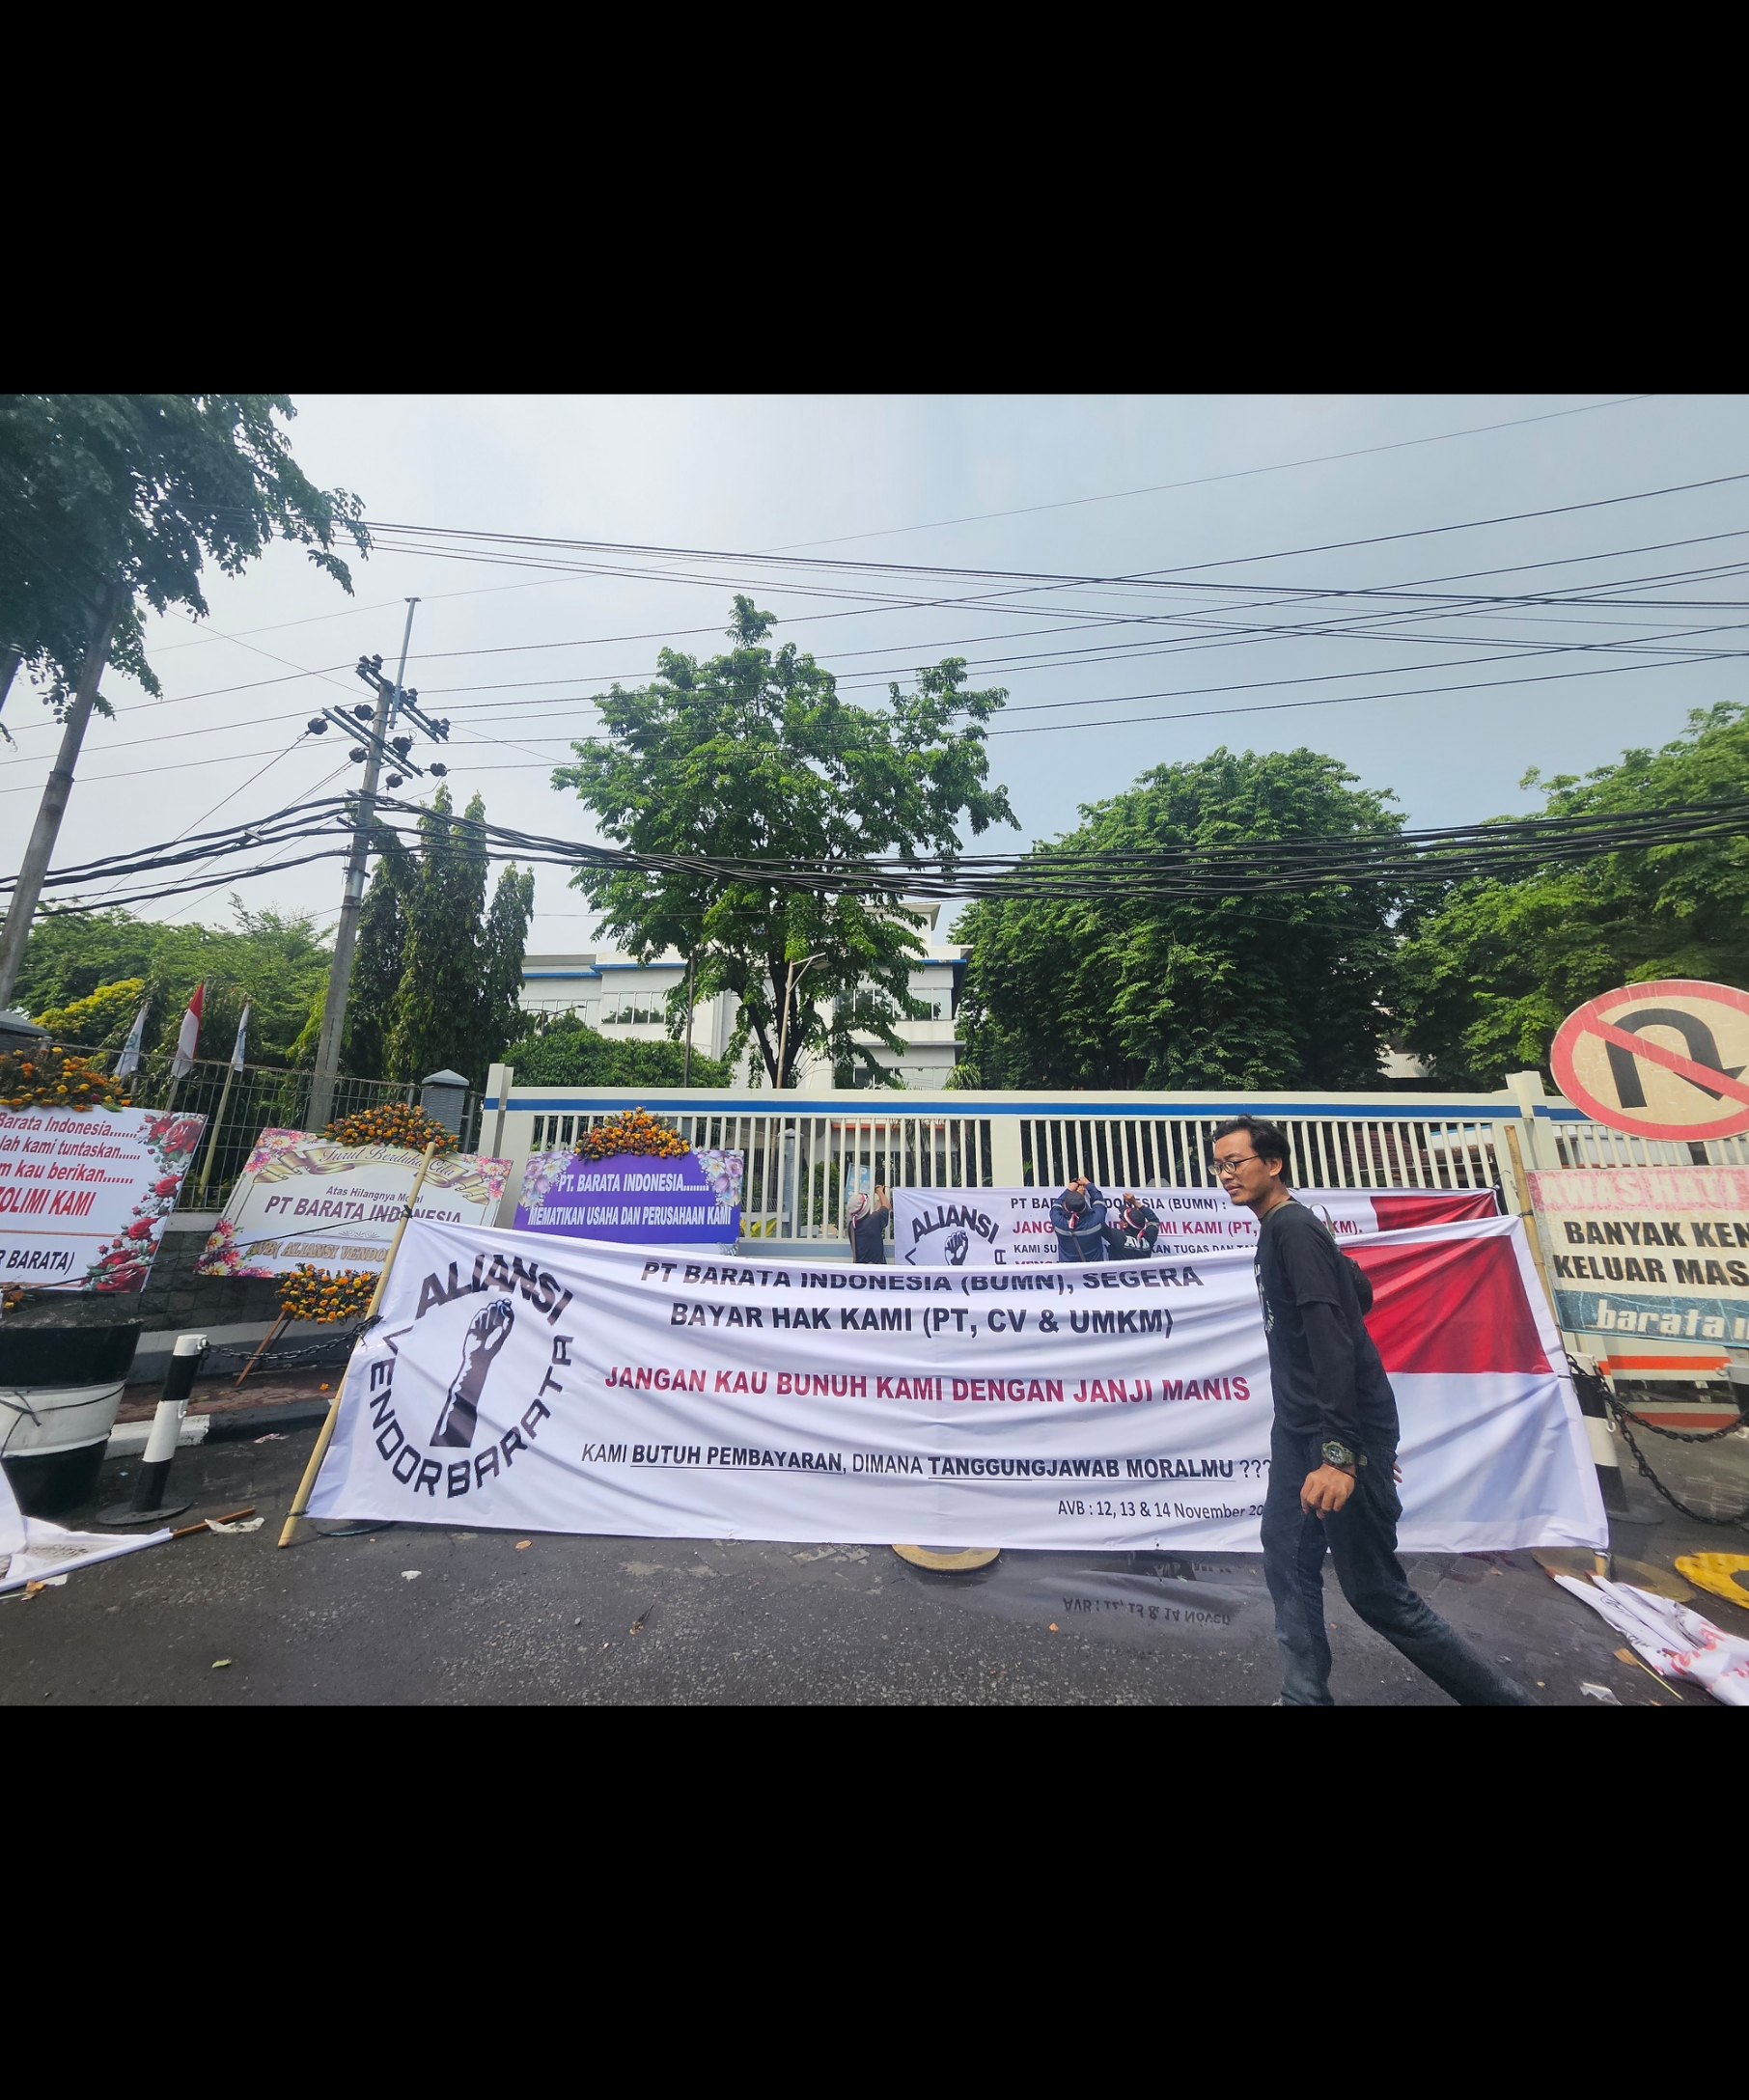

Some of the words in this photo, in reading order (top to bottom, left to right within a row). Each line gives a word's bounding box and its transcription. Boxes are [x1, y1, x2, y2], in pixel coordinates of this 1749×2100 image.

[0, 1135, 20, 1152] lah
[22, 1136, 56, 1155] kami
[14, 1159, 45, 1179] kau
[326, 1185, 348, 1197] Atas
[349, 1187, 396, 1202] Hilangnya
[397, 1193, 424, 1203] Moal
[557, 1174, 574, 1192] PT.
[576, 1174, 621, 1192] BARATA
[48, 1191, 97, 1216] KAMI
[264, 1196, 293, 1214] PT
[293, 1198, 365, 1221] BARATA
[369, 1203, 462, 1223] INDNESIA
[527, 1205, 585, 1226] MEMATIKAN
[586, 1205, 619, 1226] USAHA
[620, 1206, 640, 1226] DAN
[642, 1206, 705, 1226] PERUSAHAAN
[707, 1206, 732, 1226] KAMI
[1011, 1198, 1027, 1209] PT
[1168, 1198, 1218, 1212] (BUMN)
[911, 1204, 1000, 1245] ALIANSI
[1012, 1221, 1055, 1233] JANG
[1181, 1221, 1223, 1234] KAMI
[1228, 1221, 1258, 1237] (PT,
[1564, 1220, 1687, 1247] BANYAK
[281, 1242, 340, 1258] ALIANSI
[1013, 1244, 1041, 1254] KAMI
[1174, 1245, 1209, 1254] TUGAS
[6, 1250, 74, 1275] BARATA)
[1552, 1255, 1667, 1284] KELUAR
[415, 1254, 574, 1326] ALIANSI
[640, 1261, 677, 1283] PT
[682, 1264, 791, 1288] BARATA
[800, 1272, 953, 1290] INDONESIA
[960, 1273, 1075, 1296] (BUMN),
[1082, 1265, 1205, 1289] SEGERA
[670, 1302, 764, 1328] BAYAR
[771, 1307, 832, 1330] HAK
[840, 1307, 913, 1332] KAMI
[922, 1307, 978, 1339] (PT,
[986, 1309, 1027, 1333] CV
[1038, 1309, 1060, 1333] &
[1069, 1308, 1175, 1339] UMKM)
[1596, 1299, 1725, 1338] barata
[604, 1367, 707, 1393] JANGAN
[714, 1370, 768, 1395] KAU
[776, 1371, 868, 1397] BUNUH
[875, 1376, 943, 1401] KAMI
[952, 1378, 1065, 1402] DENGAN
[1072, 1379, 1153, 1403] JANJI
[1161, 1375, 1251, 1401] MANIS
[581, 1443, 627, 1463] KAMI
[631, 1444, 702, 1465] BUTUH
[707, 1446, 847, 1475] PEMBAYARAN,
[851, 1453, 925, 1475] DIMANA
[928, 1455, 1120, 1478] TANGGUNGJAWAB
[1126, 1458, 1235, 1478] MORALMU
[1058, 1500, 1086, 1516] AVB
[1096, 1502, 1117, 1519] 12,
[1120, 1502, 1136, 1517] 13
[1139, 1502, 1152, 1517] &
[1154, 1501, 1171, 1517] 14
[1175, 1503, 1246, 1519] November
[1248, 1505, 1264, 1516] 20
